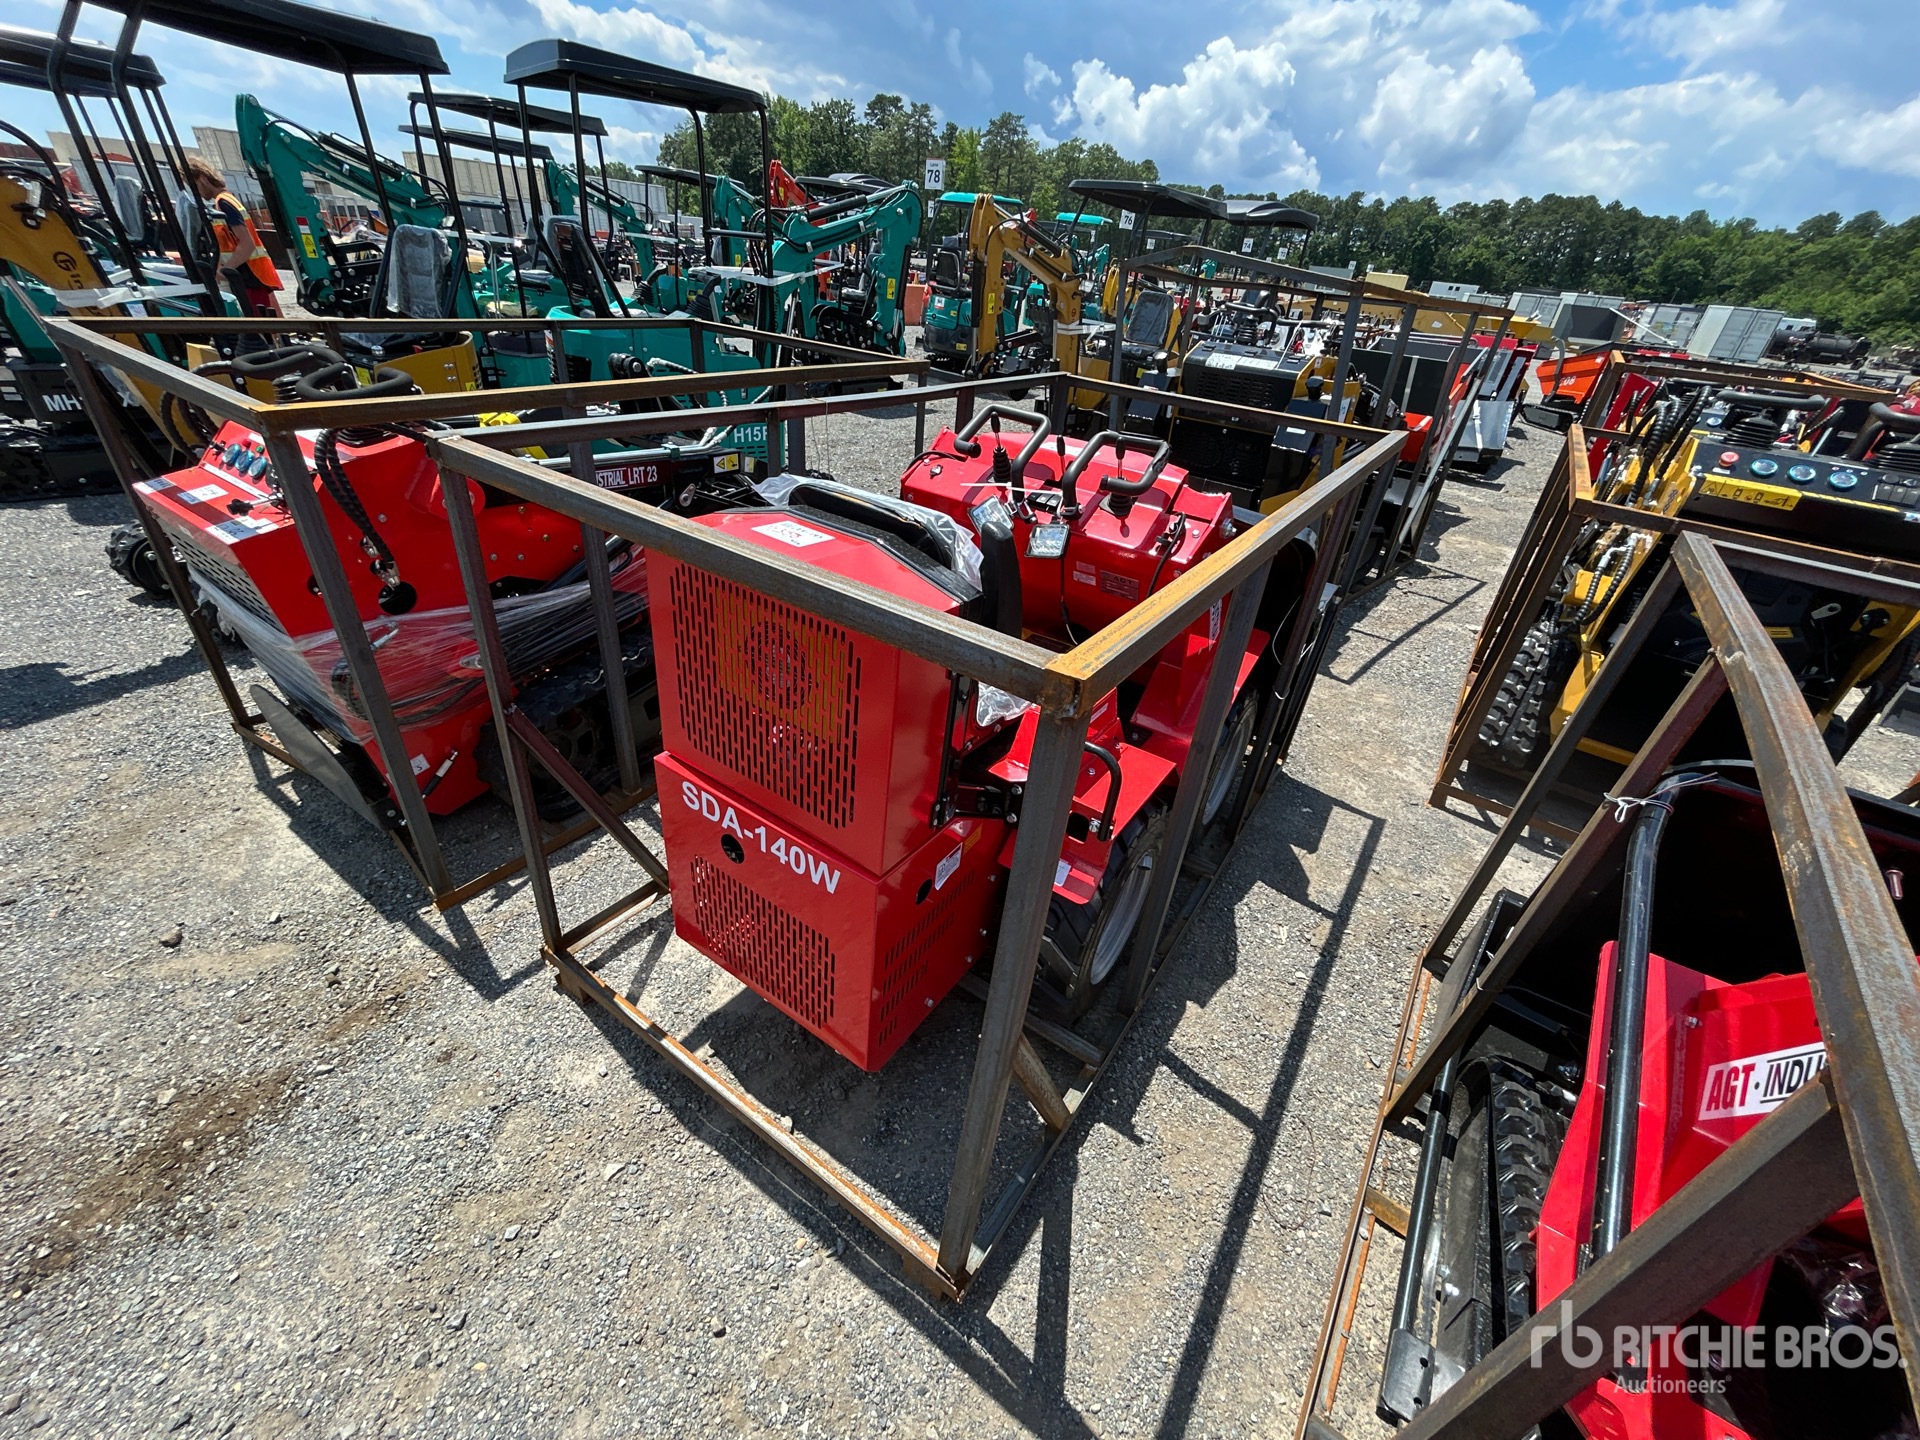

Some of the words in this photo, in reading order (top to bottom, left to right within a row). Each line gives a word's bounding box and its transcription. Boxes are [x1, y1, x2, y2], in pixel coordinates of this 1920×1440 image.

[927, 169, 941, 183] 78
[1124, 215, 1133, 225] 76
[628, 466, 645, 485] LRT
[647, 465, 658, 482] 23
[682, 781, 841, 894] SDA-140W
[1705, 1063, 1756, 1112] AGT
